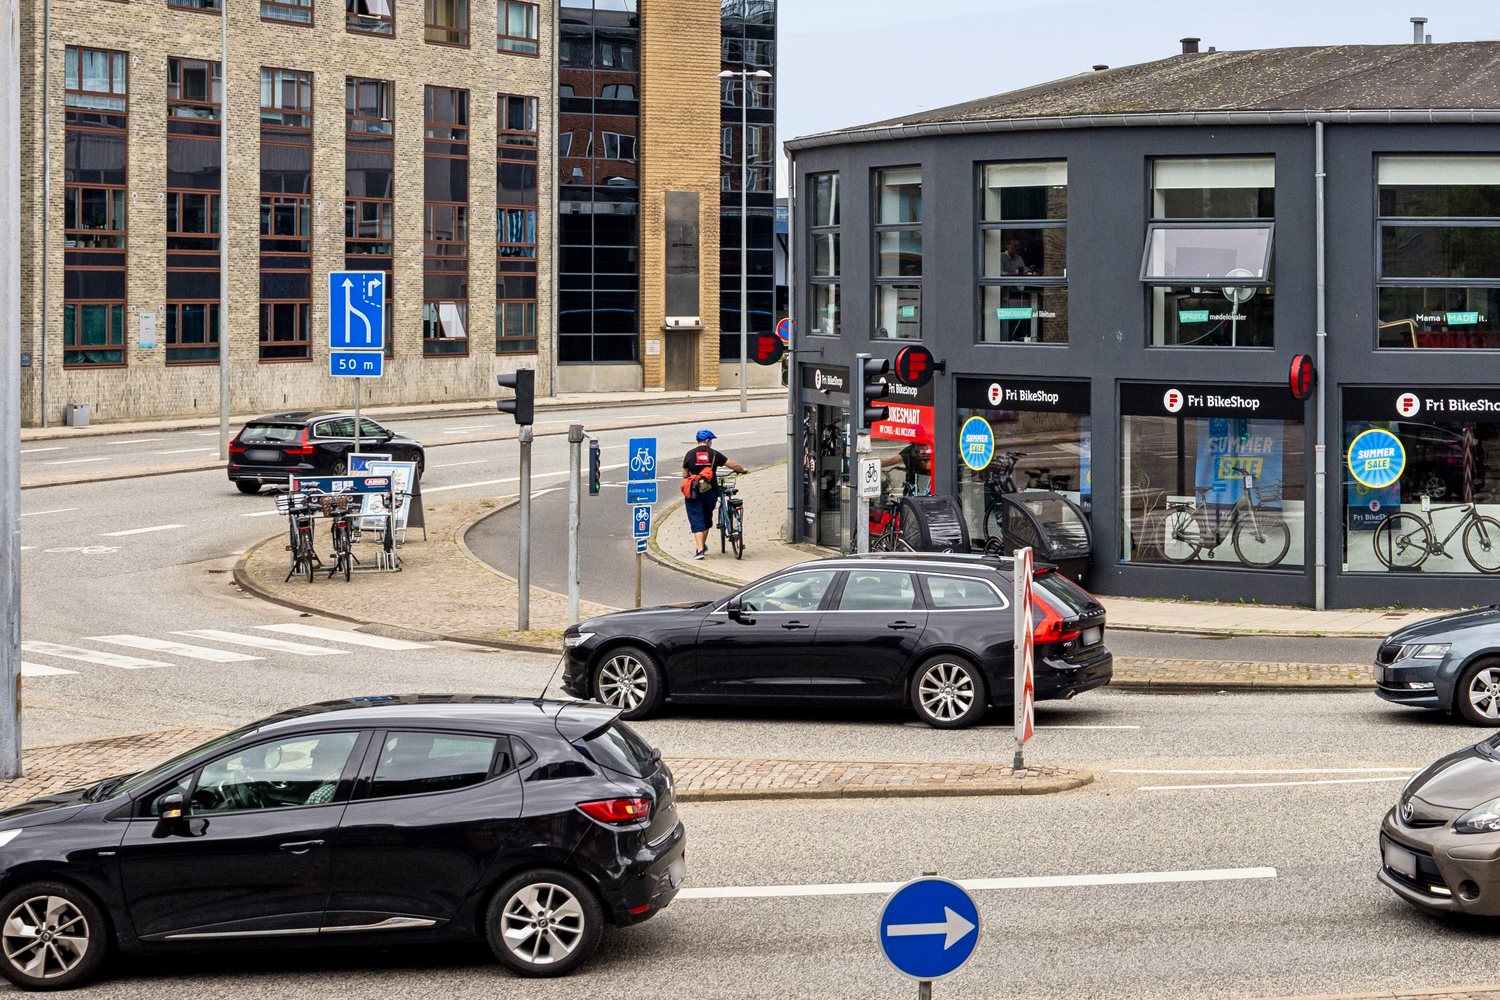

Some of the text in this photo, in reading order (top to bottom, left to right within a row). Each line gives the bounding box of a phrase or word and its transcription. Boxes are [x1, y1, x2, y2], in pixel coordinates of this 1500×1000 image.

[1039, 310, 1056, 319] libitum
[1209, 312, 1247, 322] mødelokaler
[1416, 313, 1441, 322] Mama
[1448, 313, 1477, 322] MADE
[1478, 313, 1488, 322] it.
[338, 358, 374, 370] 50 m
[828, 375, 843, 388] BikeShop
[888, 382, 918, 398] Fri BikeShop
[1005, 389, 1018, 401] Fri
[1019, 389, 1059, 405] BikeShop
[1187, 395, 1204, 407] Fri
[1206, 395, 1260, 411] BikeShop
[1425, 399, 1444, 411] Fri
[966, 434, 989, 443] SUMMER
[971, 444, 984, 453] SALE
[1208, 436, 1273, 454] SUMMER
[1358, 447, 1395, 459] SUMMER
[1222, 459, 1258, 476] SALE
[1367, 458, 1387, 469] SALE
[1353, 513, 1364, 521] Fri
